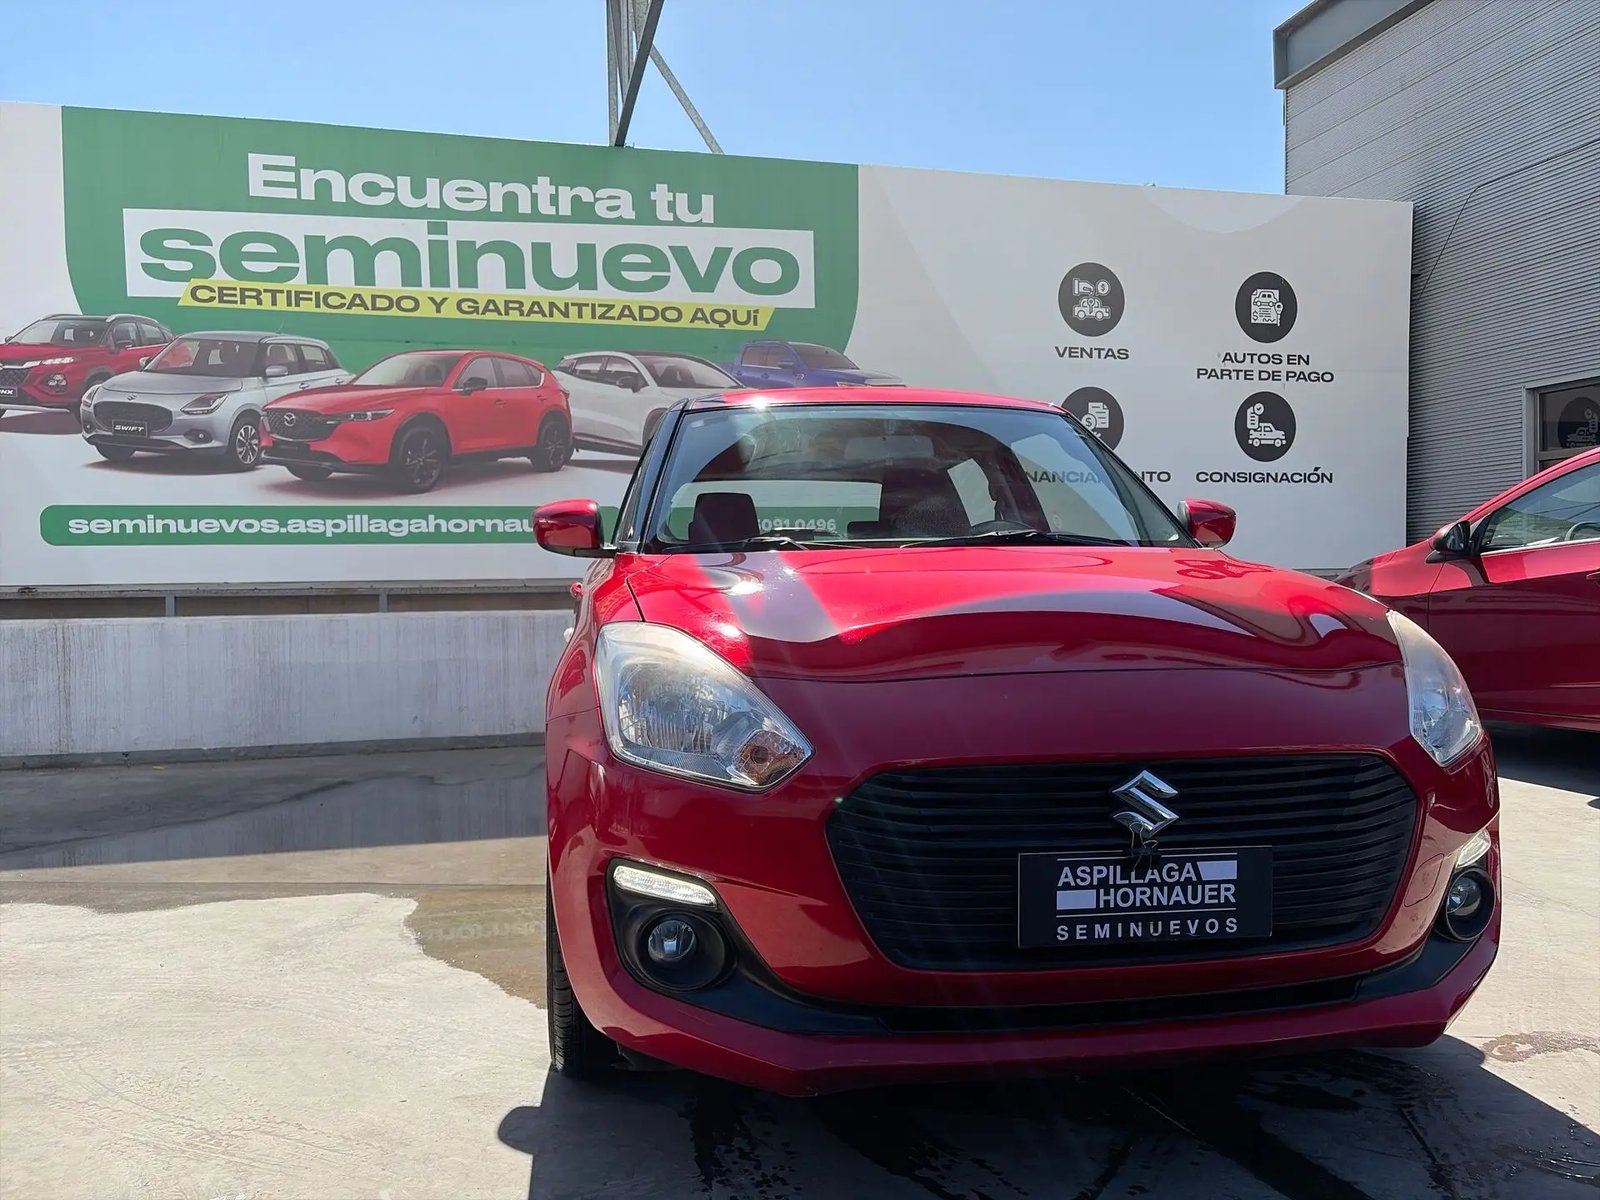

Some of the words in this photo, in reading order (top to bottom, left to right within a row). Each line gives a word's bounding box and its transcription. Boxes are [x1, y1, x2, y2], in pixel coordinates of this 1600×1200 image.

[248, 153, 635, 219] Encuentra
[650, 183, 714, 223] tu
[139, 220, 800, 295] seminuevo
[190, 285, 420, 314] CERTIFICADO
[429, 297, 449, 314] Y
[456, 298, 681, 322] GARANTIZADO
[1054, 346, 1130, 360] VENTAS
[1221, 352, 1283, 366] AUTOS
[1287, 354, 1310, 366] EN
[1196, 368, 1254, 381] PARTE
[1258, 369, 1282, 382] DE
[1285, 370, 1334, 383] PAGO
[113, 424, 145, 432] SWIFT
[1196, 467, 1333, 484] CONSIGNACIÓN
[68, 514, 534, 537] seminuevos.aspillagahornau
[1057, 862, 1197, 887] ASPILLAGA
[1099, 883, 1236, 909] HORNAUER
[1056, 917, 1238, 941] SEMINUEVOS
